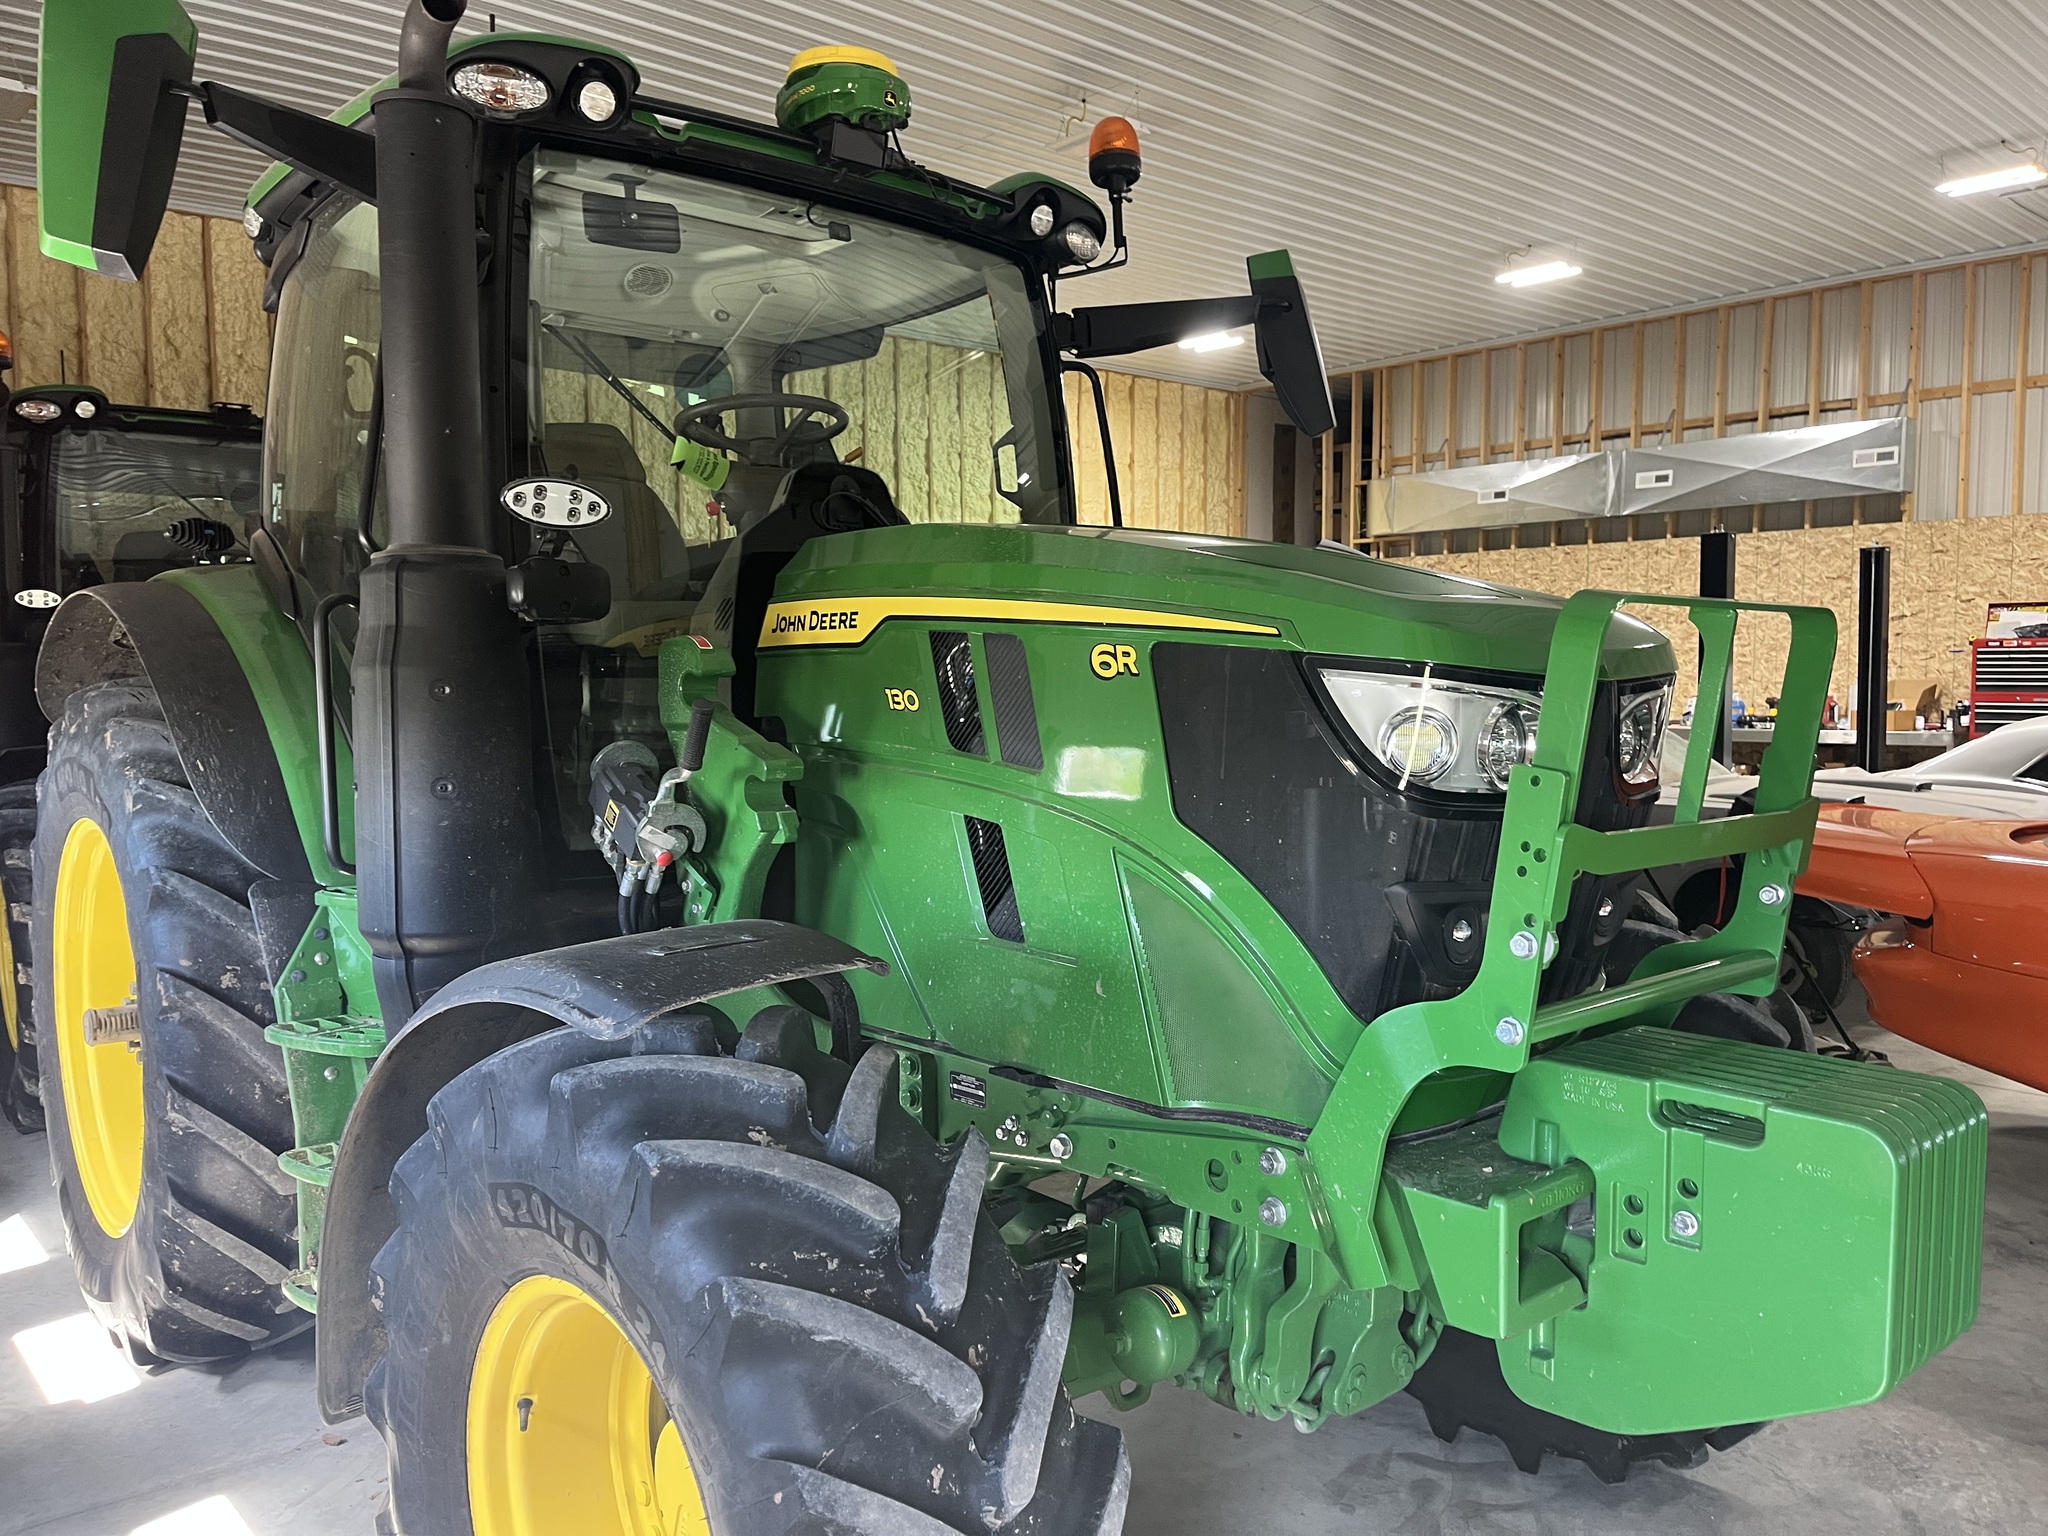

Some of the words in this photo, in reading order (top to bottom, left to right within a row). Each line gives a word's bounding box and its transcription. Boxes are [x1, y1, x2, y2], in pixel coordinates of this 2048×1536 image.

[771, 613, 806, 633] JOHN
[809, 610, 859, 631] DEERE
[1090, 643, 1140, 680] 6R
[884, 687, 920, 712] 130
[1605, 1100, 1625, 1113] USA
